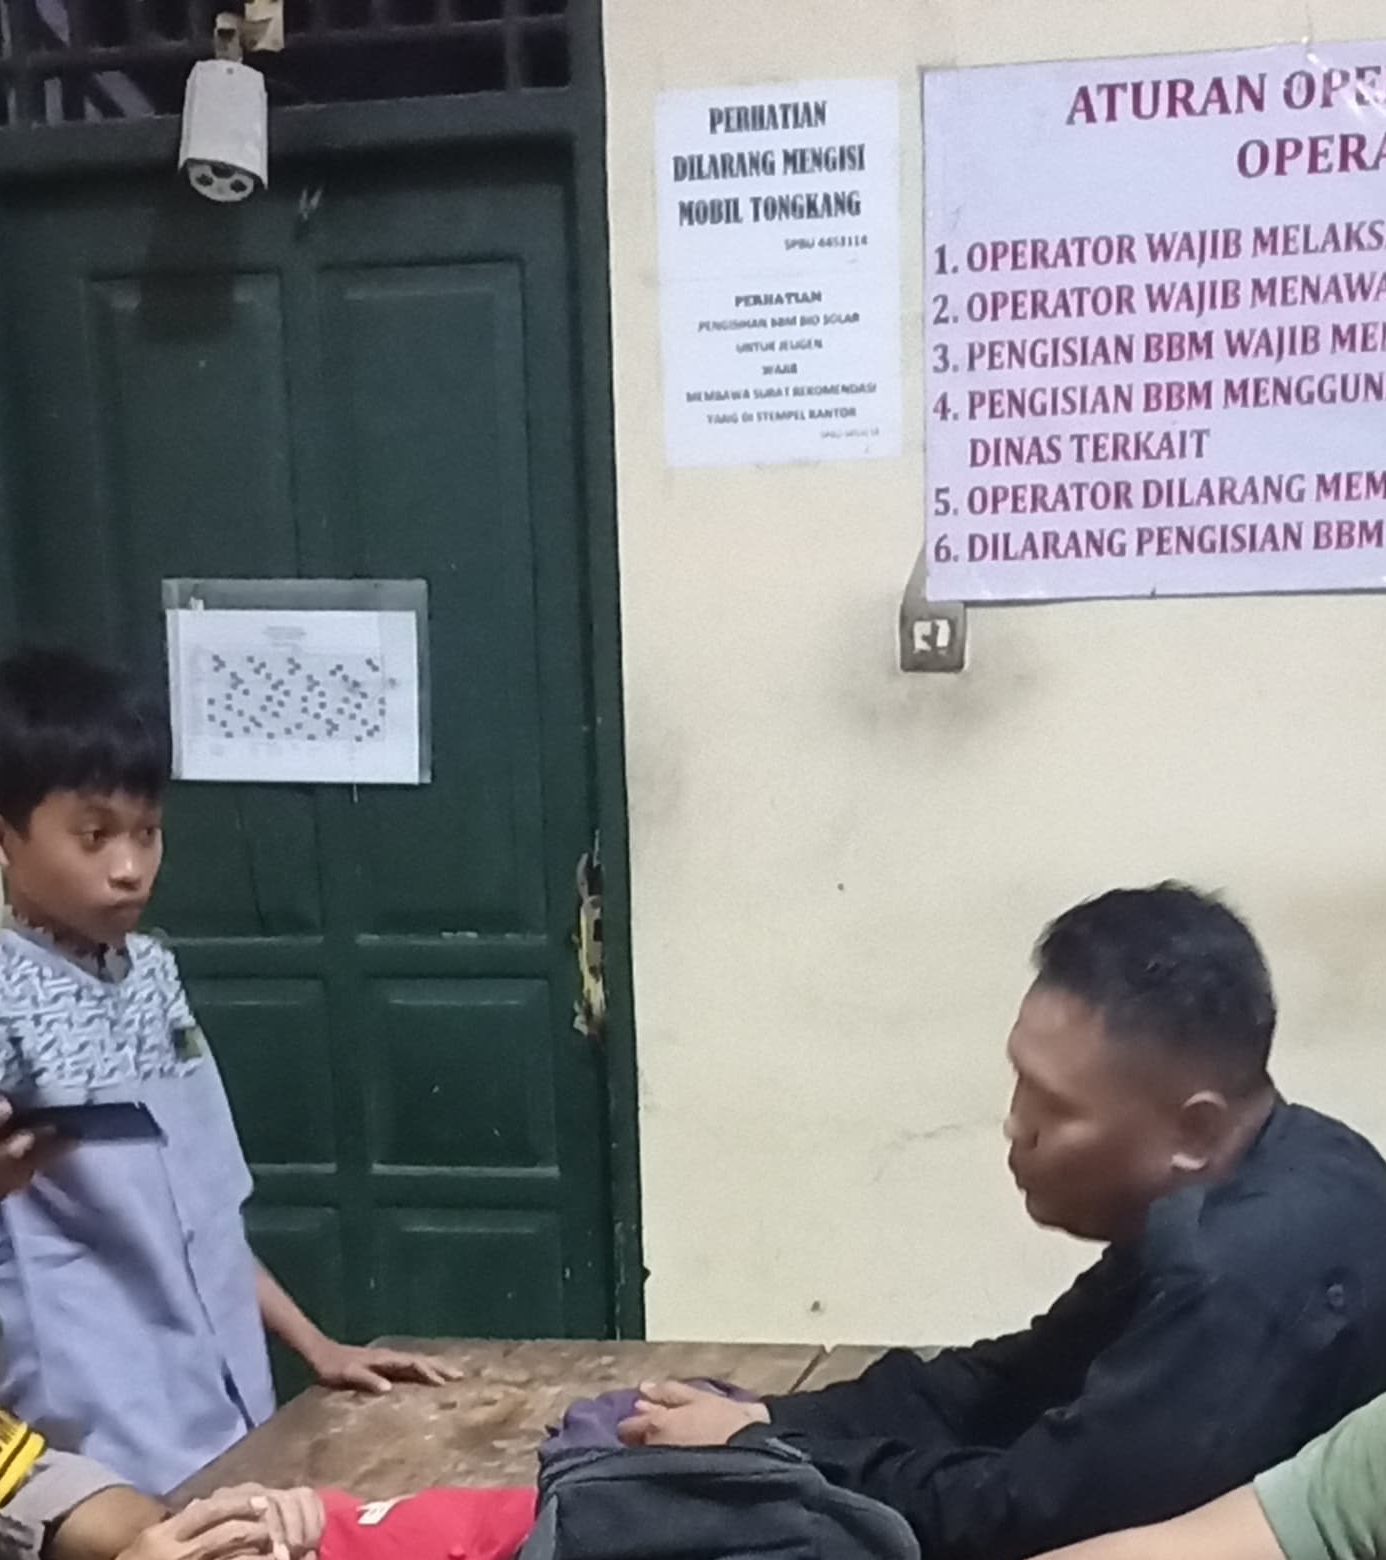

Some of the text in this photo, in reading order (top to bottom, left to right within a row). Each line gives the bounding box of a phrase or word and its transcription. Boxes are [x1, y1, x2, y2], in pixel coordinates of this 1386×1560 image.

[709, 100, 827, 134] PERHATIAN
[1065, 73, 1267, 126] ATURAN
[673, 144, 865, 182] DILARANG MENGISI
[679, 191, 861, 226] MOBIL TONGKANG
[935, 244, 958, 275] 1.
[967, 234, 1136, 272] OPERATOR
[1145, 228, 1242, 268] WAJIB
[933, 294, 958, 325] 2.
[967, 285, 1136, 322] OPERATOR
[1145, 279, 1240, 318] WAJIB
[933, 343, 959, 373] 3.
[967, 334, 1134, 372] PENGISIAN
[1144, 330, 1213, 362] BBM
[1224, 325, 1320, 363] WAJIB
[933, 392, 958, 421] 4.
[968, 384, 1133, 420] PENGISIAN
[1143, 380, 1212, 412] BBM
[970, 429, 1210, 468] DINAS TERKAIT
[934, 487, 958, 516] 5.
[968, 481, 1133, 515] OPERATOR
[1143, 474, 1305, 509] DILARANG
[934, 534, 959, 563] 6.
[968, 528, 1126, 562] DILARANG
[1136, 522, 1303, 556] PENGISIAN
[1313, 519, 1384, 550] BBM
